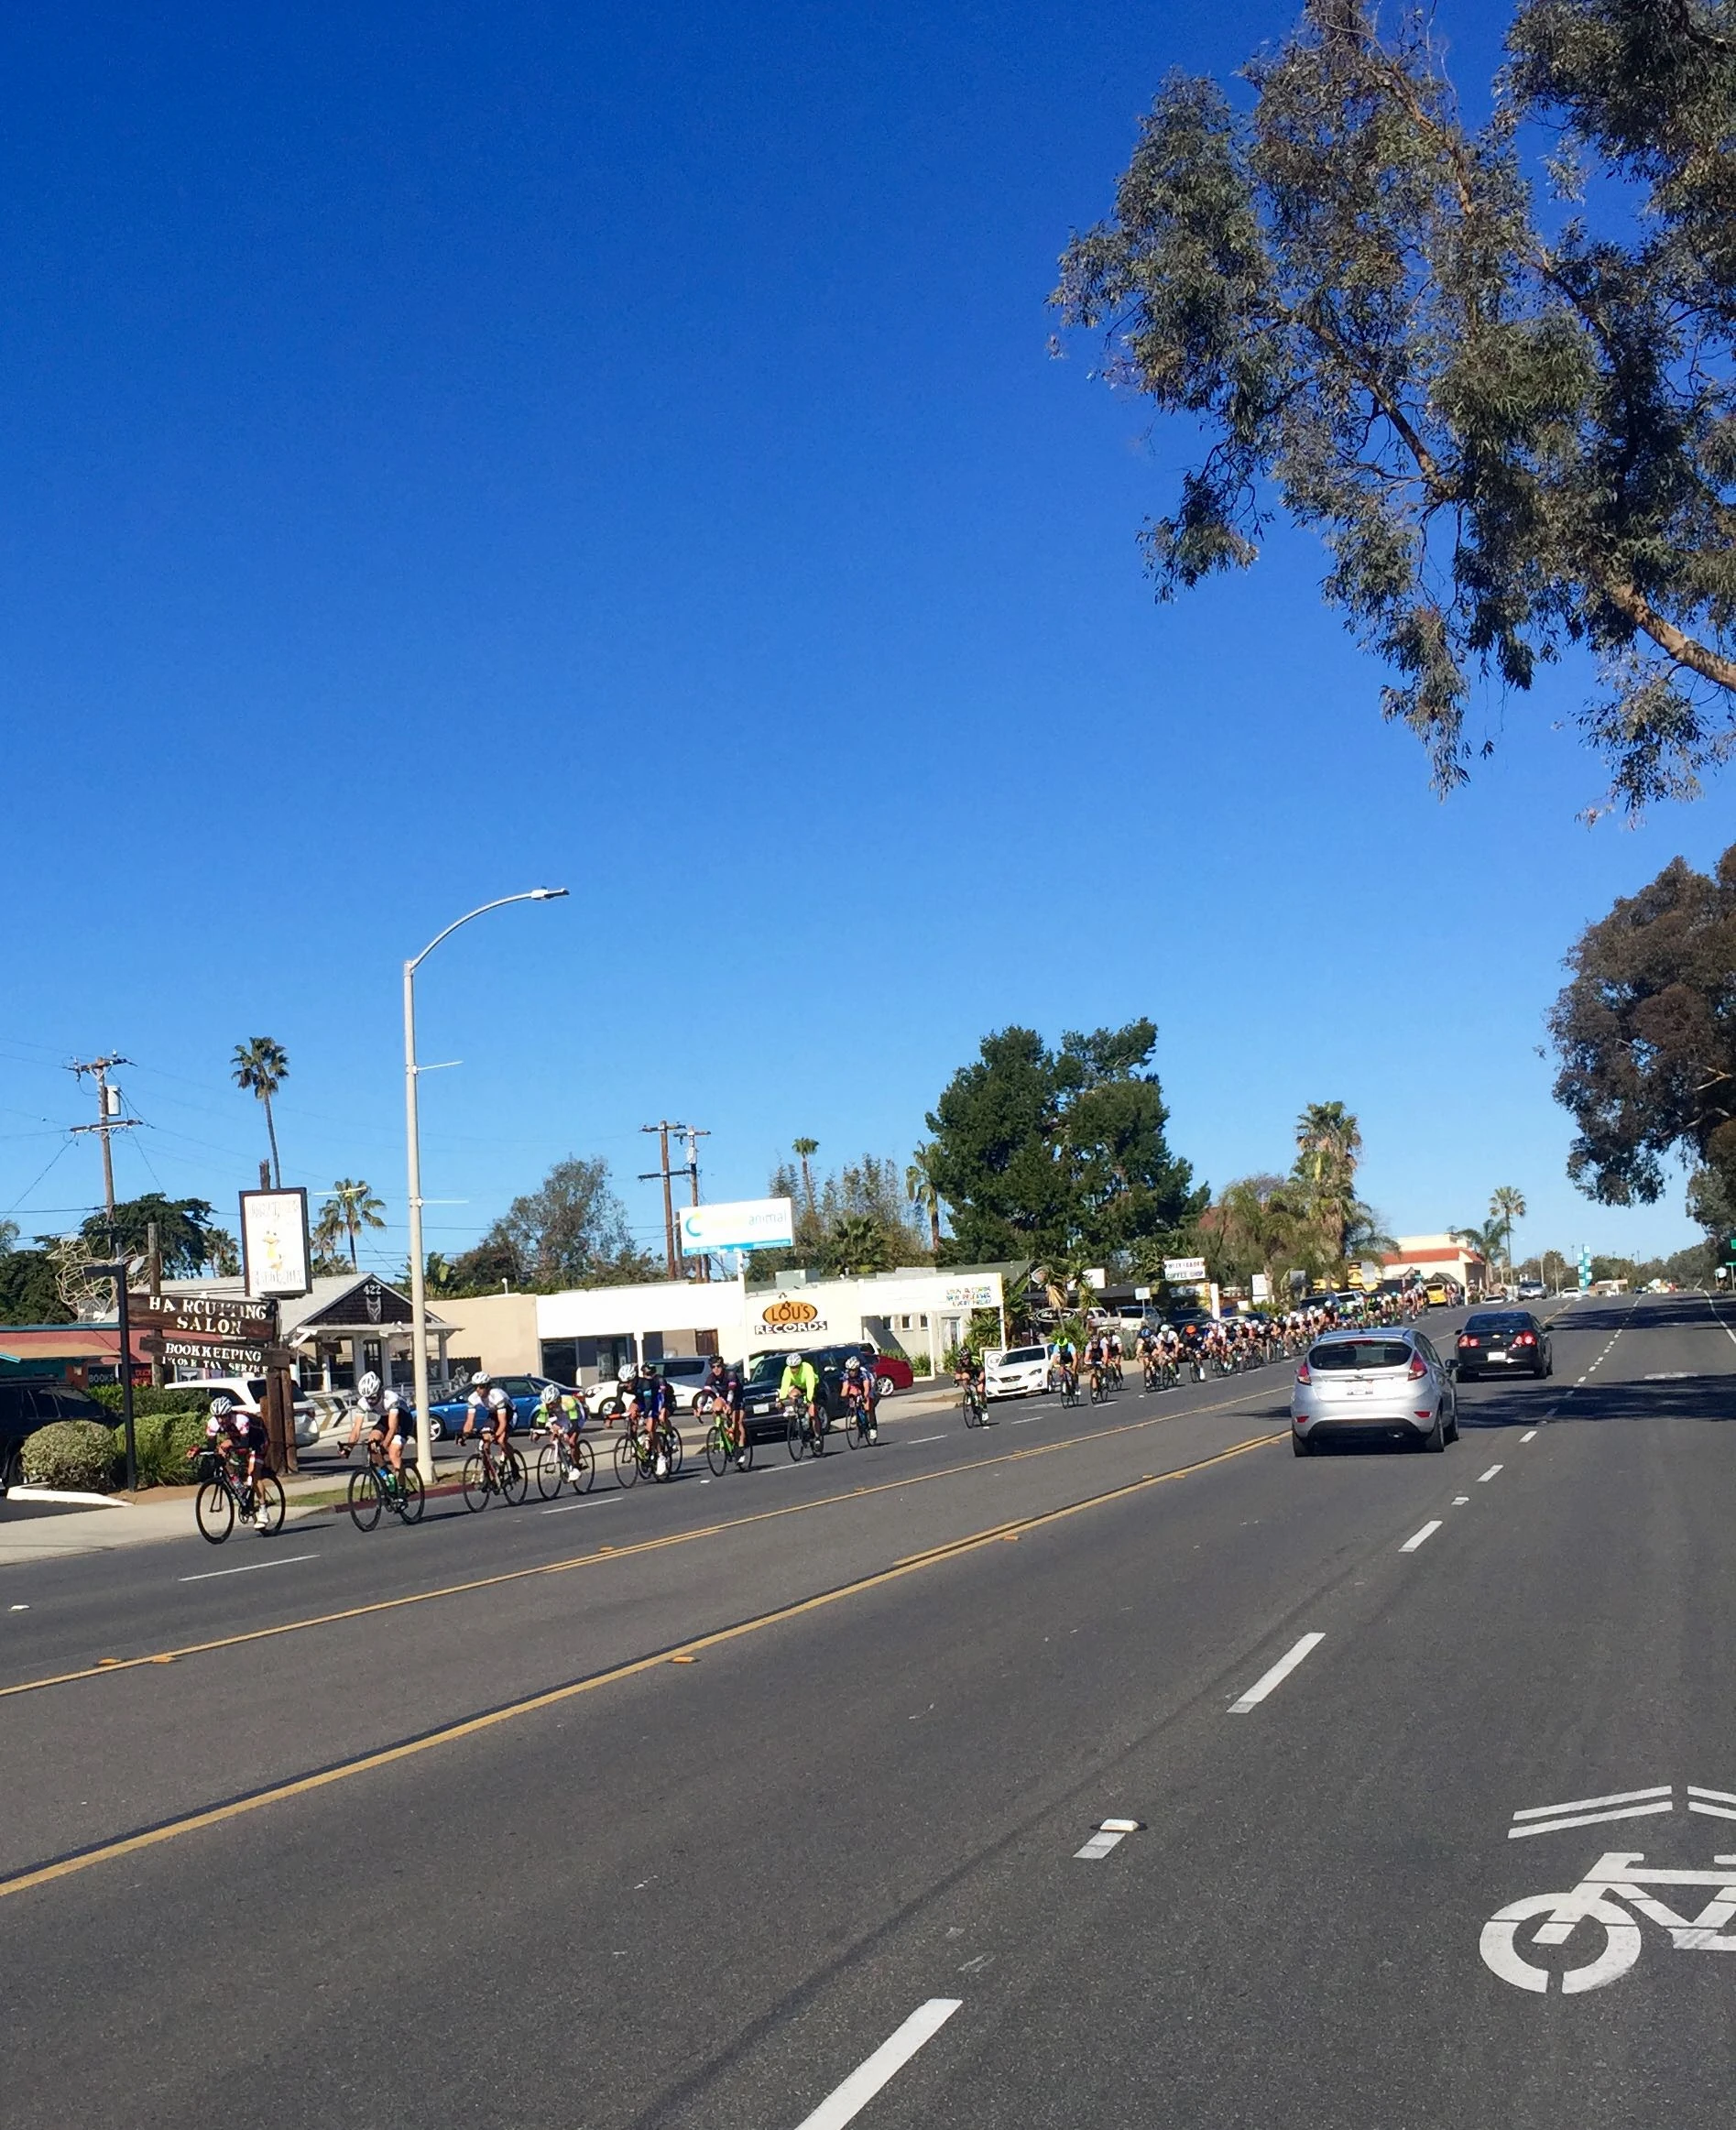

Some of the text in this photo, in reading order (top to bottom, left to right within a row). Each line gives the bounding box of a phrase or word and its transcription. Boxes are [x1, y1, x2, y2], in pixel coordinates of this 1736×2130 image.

[748, 1209, 788, 1226] animal
[363, 1284, 382, 1295] 422
[771, 1305, 810, 1321] LOU'S
[176, 1316, 242, 1335] SALON
[755, 1321, 827, 1335] RECORDS
[165, 1341, 262, 1363] BOOKKEEPING
[88, 1372, 115, 1383] BOOKS
